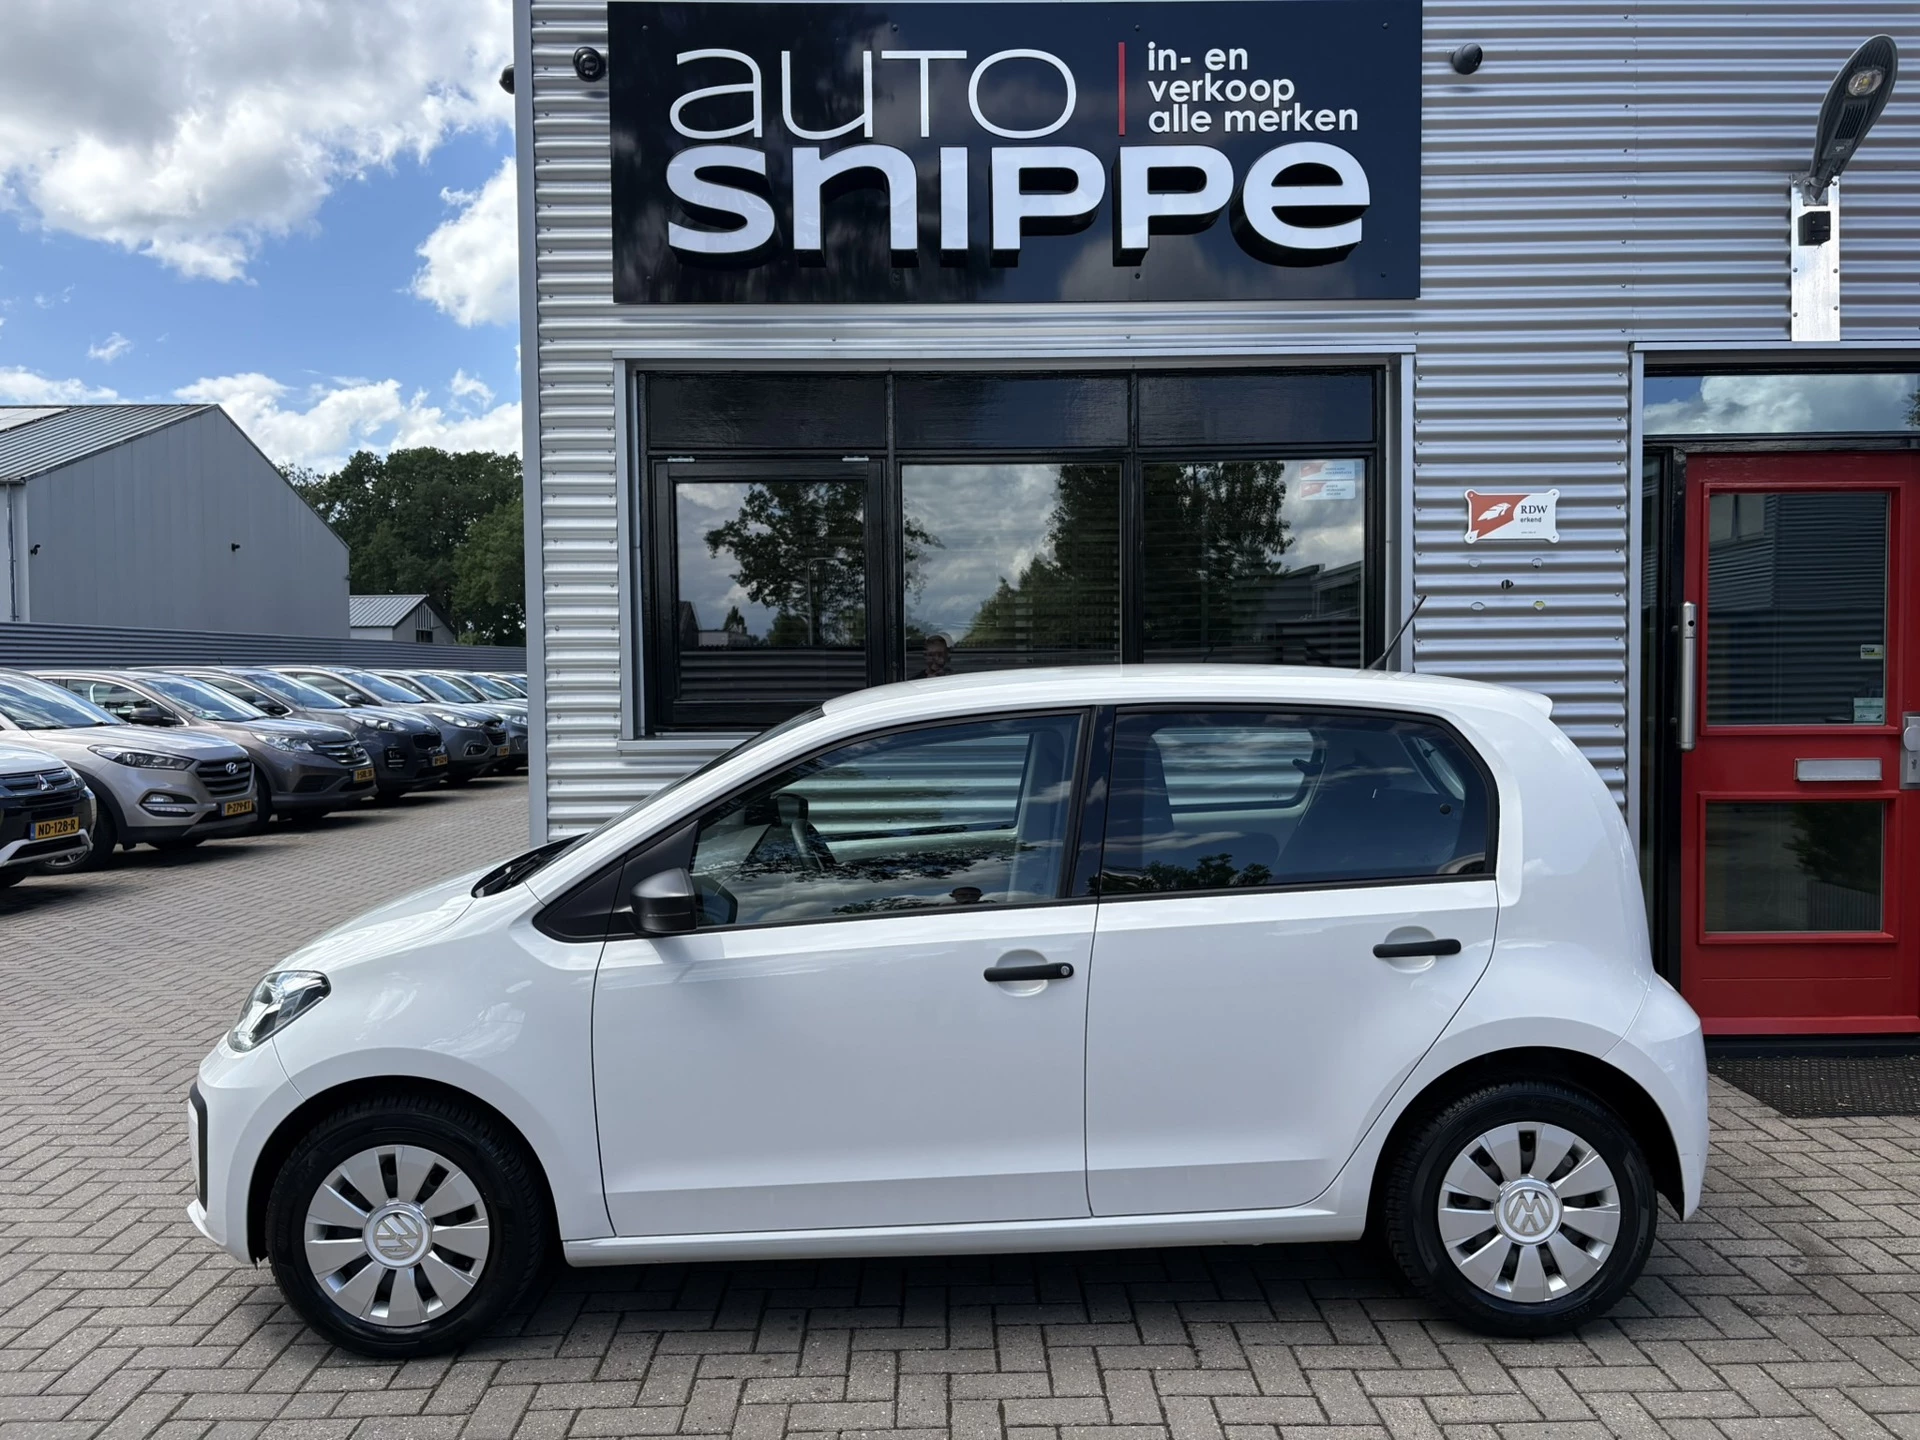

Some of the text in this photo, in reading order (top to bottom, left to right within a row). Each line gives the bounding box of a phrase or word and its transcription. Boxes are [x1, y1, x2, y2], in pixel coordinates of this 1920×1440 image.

[1147, 41, 1248, 71] in- en
[1147, 72, 1296, 108] verkoop
[1148, 102, 1358, 133] alle merken
[1520, 504, 1548, 515] RDW
[38, 819, 76, 836] ND-128-R
